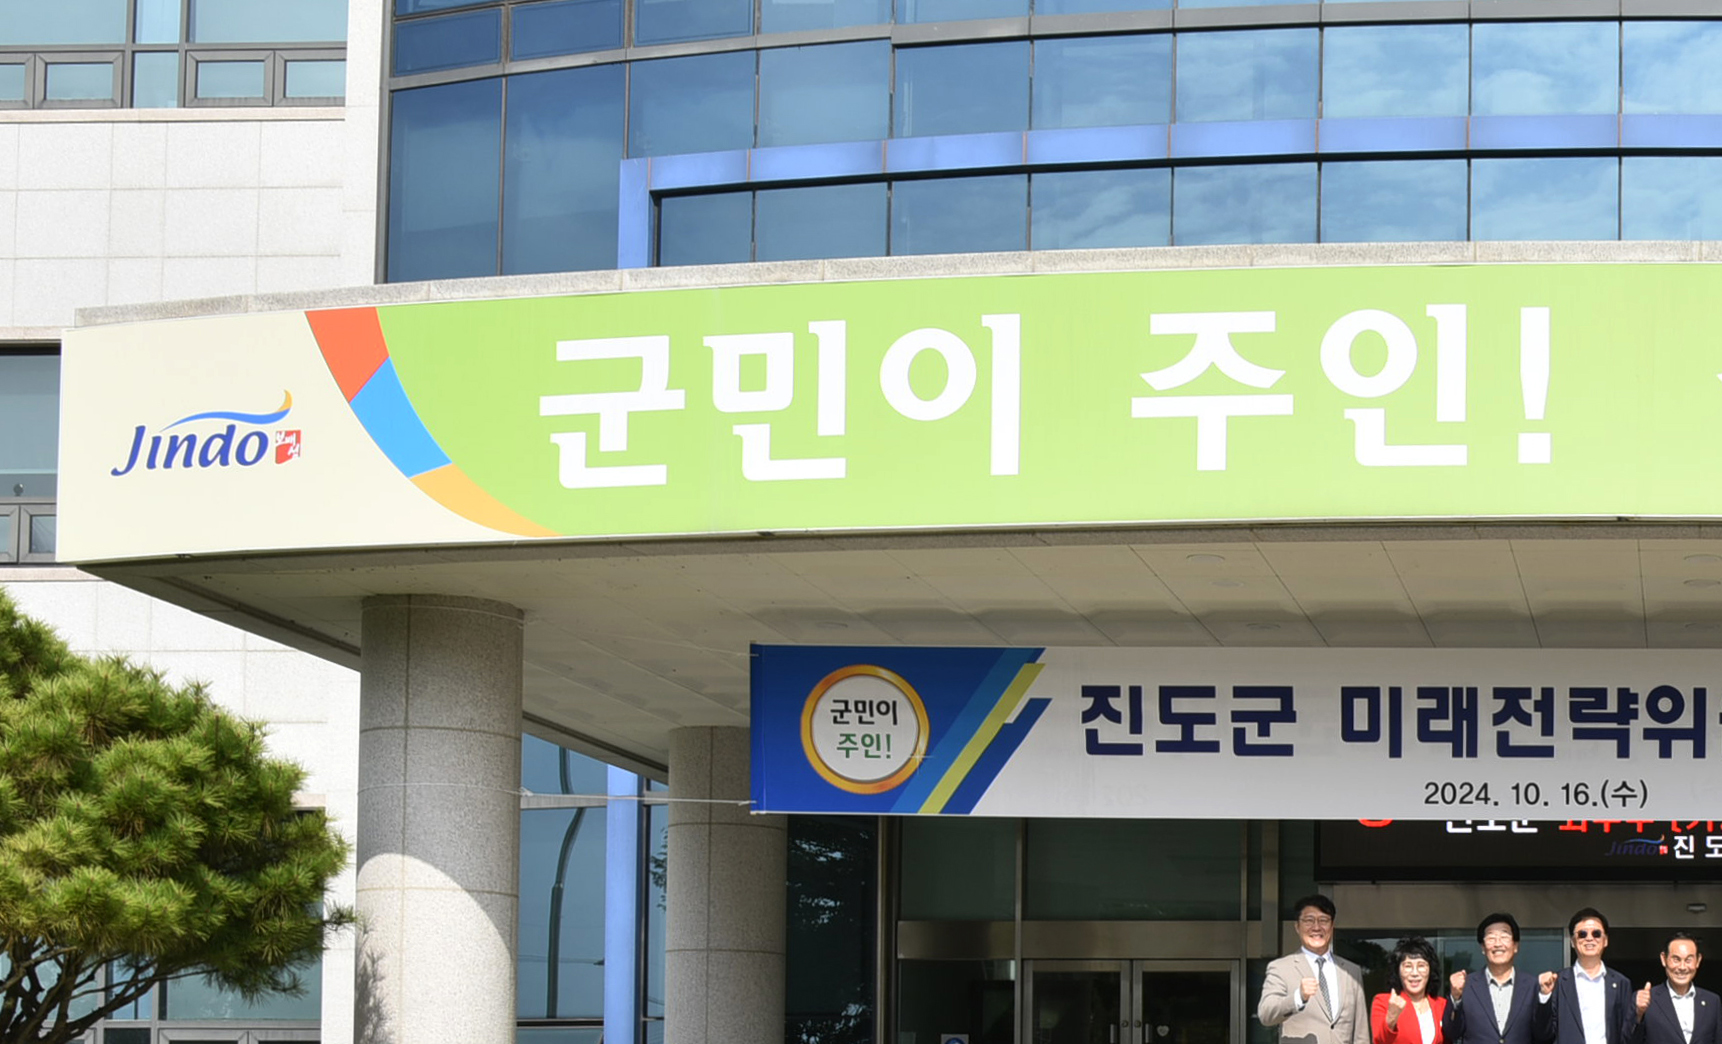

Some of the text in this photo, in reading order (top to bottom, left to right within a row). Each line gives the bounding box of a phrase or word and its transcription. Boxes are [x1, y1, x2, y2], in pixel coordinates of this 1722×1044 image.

[538, 312, 1021, 489] 군민이
[1131, 304, 1552, 471] 주인!
[110, 424, 269, 476] Jindo
[830, 699, 898, 726] 군민이
[1080, 684, 1297, 757] 진도군
[836, 733, 891, 759] 주인!
[1424, 779, 1648, 809] 2024. 10. 16.(수)
